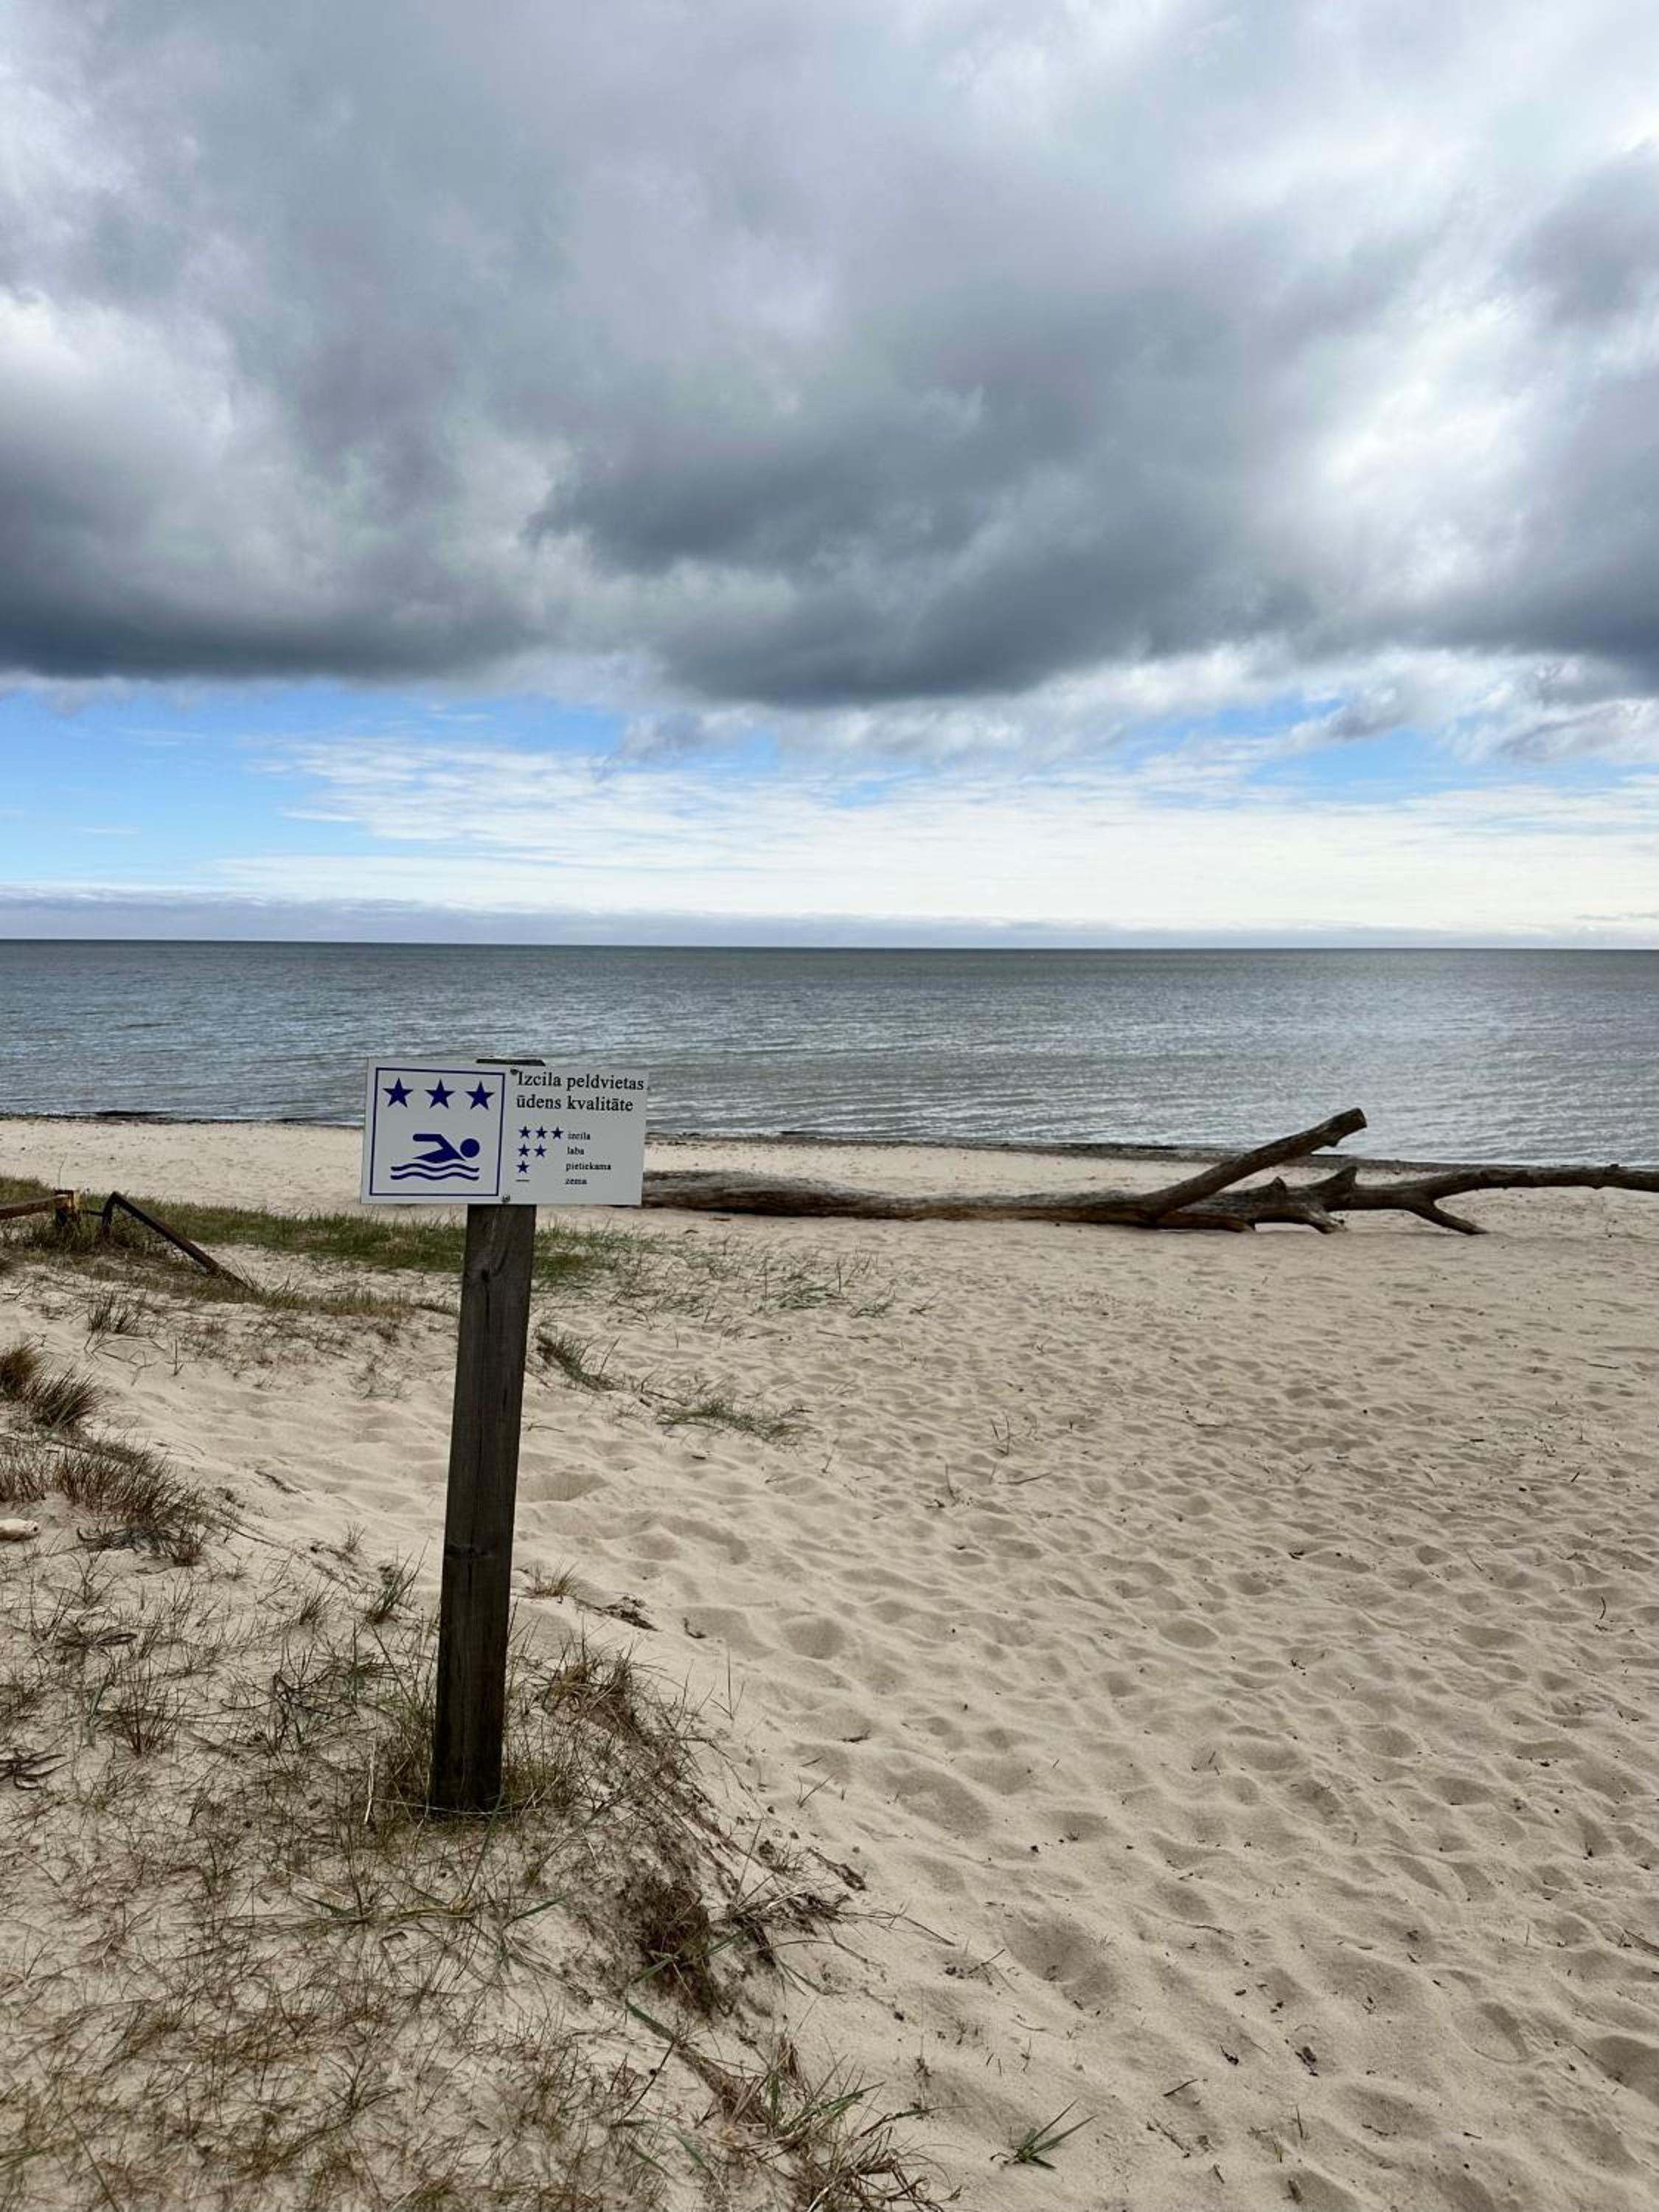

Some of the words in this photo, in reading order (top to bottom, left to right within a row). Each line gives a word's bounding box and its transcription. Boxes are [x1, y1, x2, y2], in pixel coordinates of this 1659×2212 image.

[518, 1071, 562, 1086] Izcila
[566, 1074, 644, 1091] peldvietas
[517, 1094, 561, 1109] ūdens
[567, 1096, 633, 1111] kvalitāte
[568, 1132, 591, 1140] izcila
[567, 1147, 585, 1155] laba
[566, 1162, 611, 1172] pietiekama
